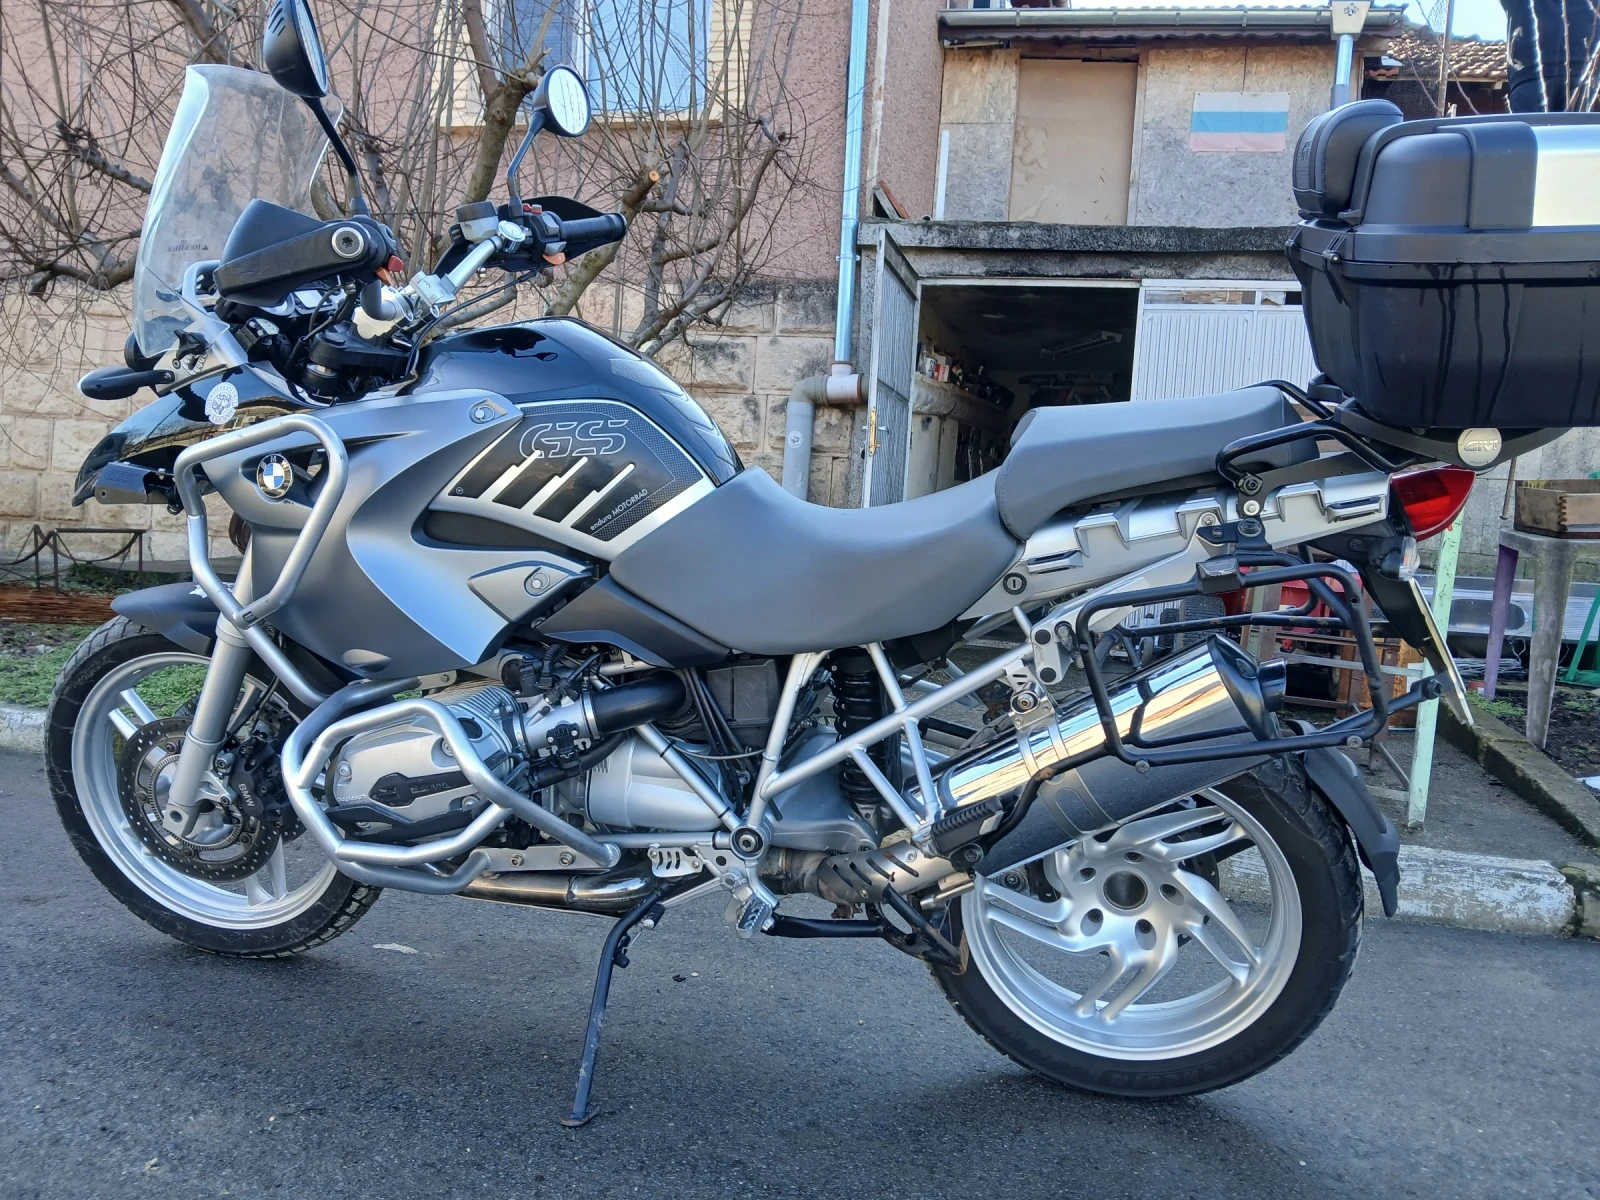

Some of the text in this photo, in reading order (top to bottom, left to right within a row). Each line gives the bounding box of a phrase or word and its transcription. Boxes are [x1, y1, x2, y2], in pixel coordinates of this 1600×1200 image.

[519, 420, 629, 459] GS
[1463, 439, 1498, 451] GIVI
[590, 488, 648, 531] enduro MOTORRAD
[239, 783, 255, 807] BMW
